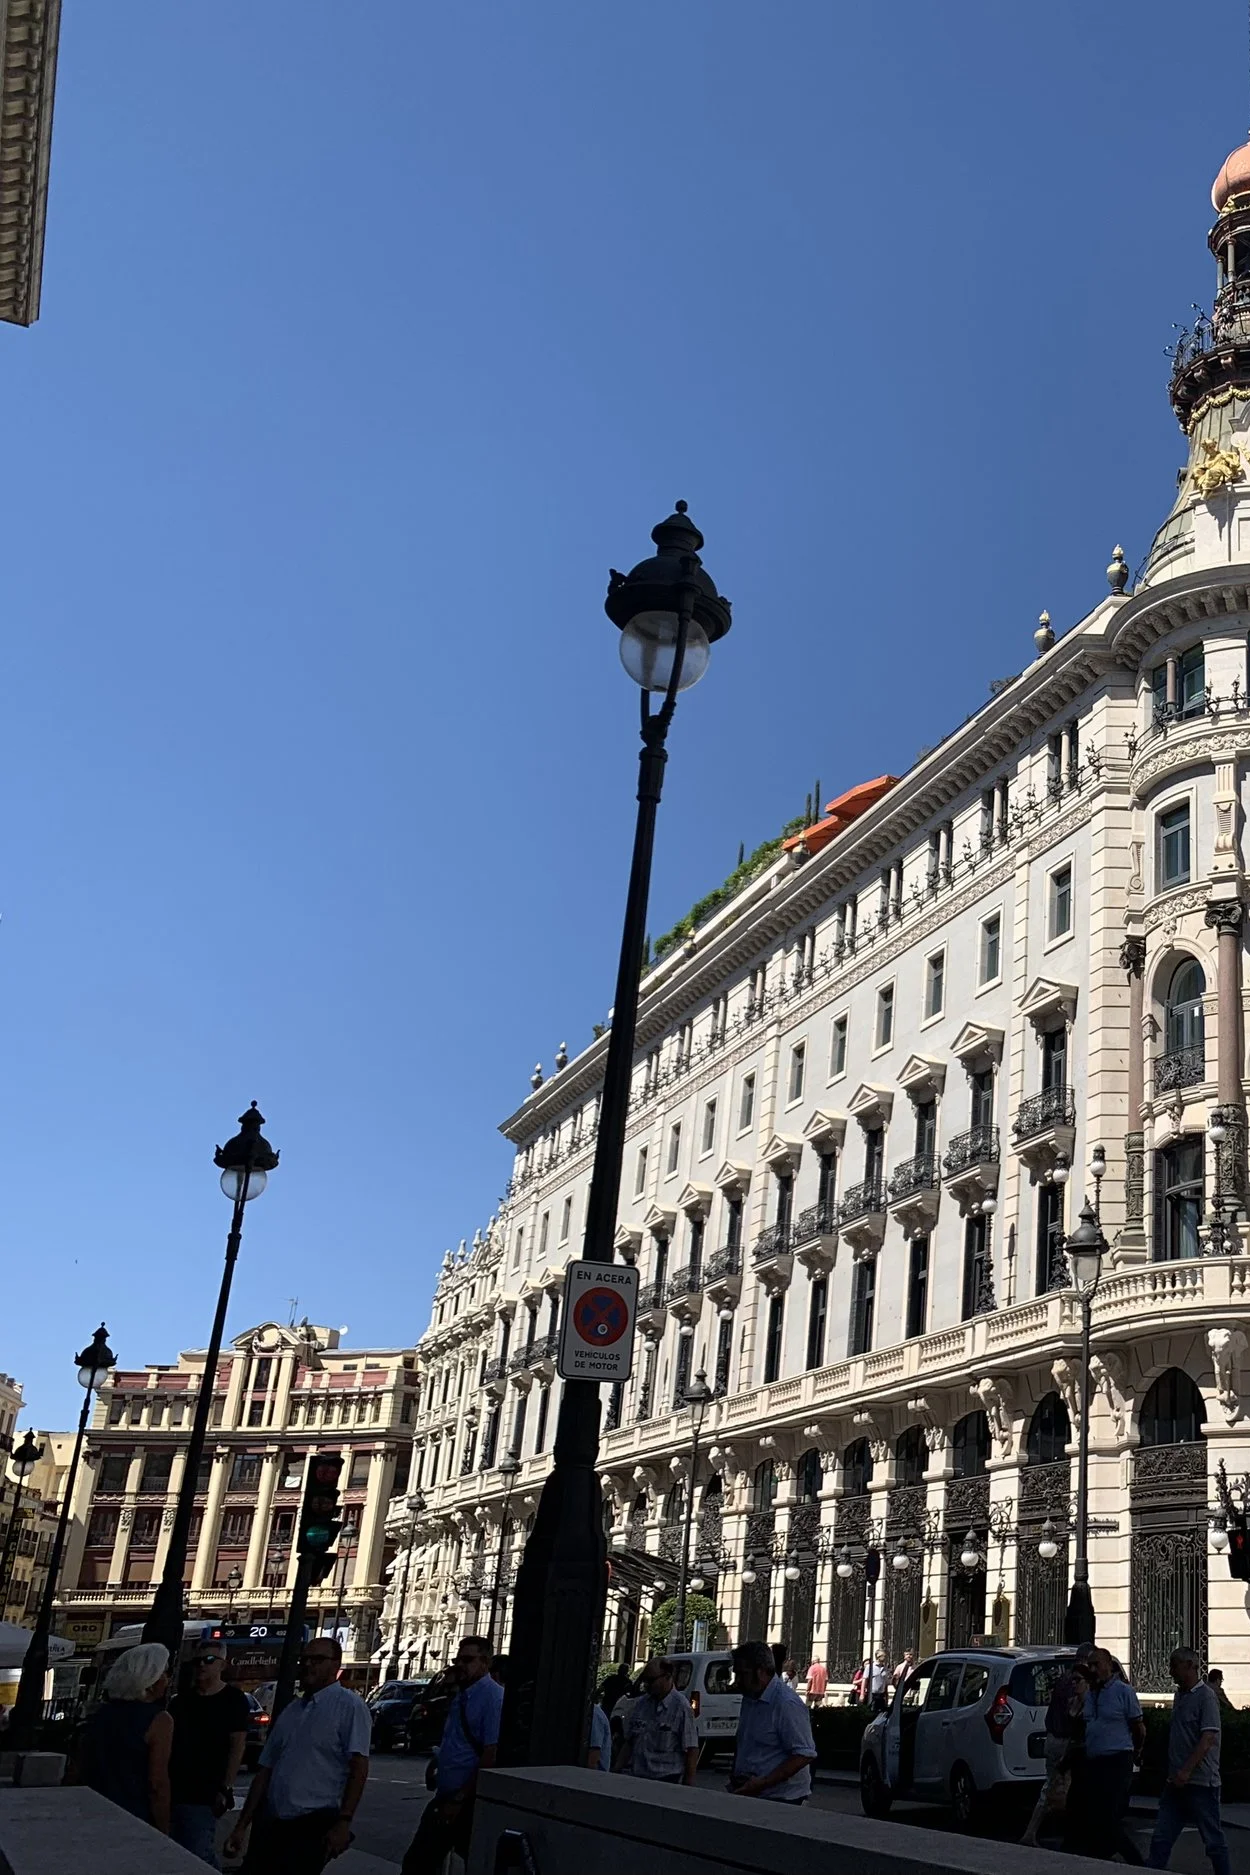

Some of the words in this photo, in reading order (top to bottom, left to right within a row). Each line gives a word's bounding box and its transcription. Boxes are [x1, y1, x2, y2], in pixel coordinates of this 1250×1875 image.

[577, 1271, 592, 1281] EN
[596, 1273, 632, 1285] ACERA
[574, 1361, 586, 1369] DE
[588, 1362, 619, 1372] MOTOR
[73, 1624, 98, 1632] ORO
[249, 1626, 268, 1638] 20
[230, 1656, 277, 1666] Candlelight
